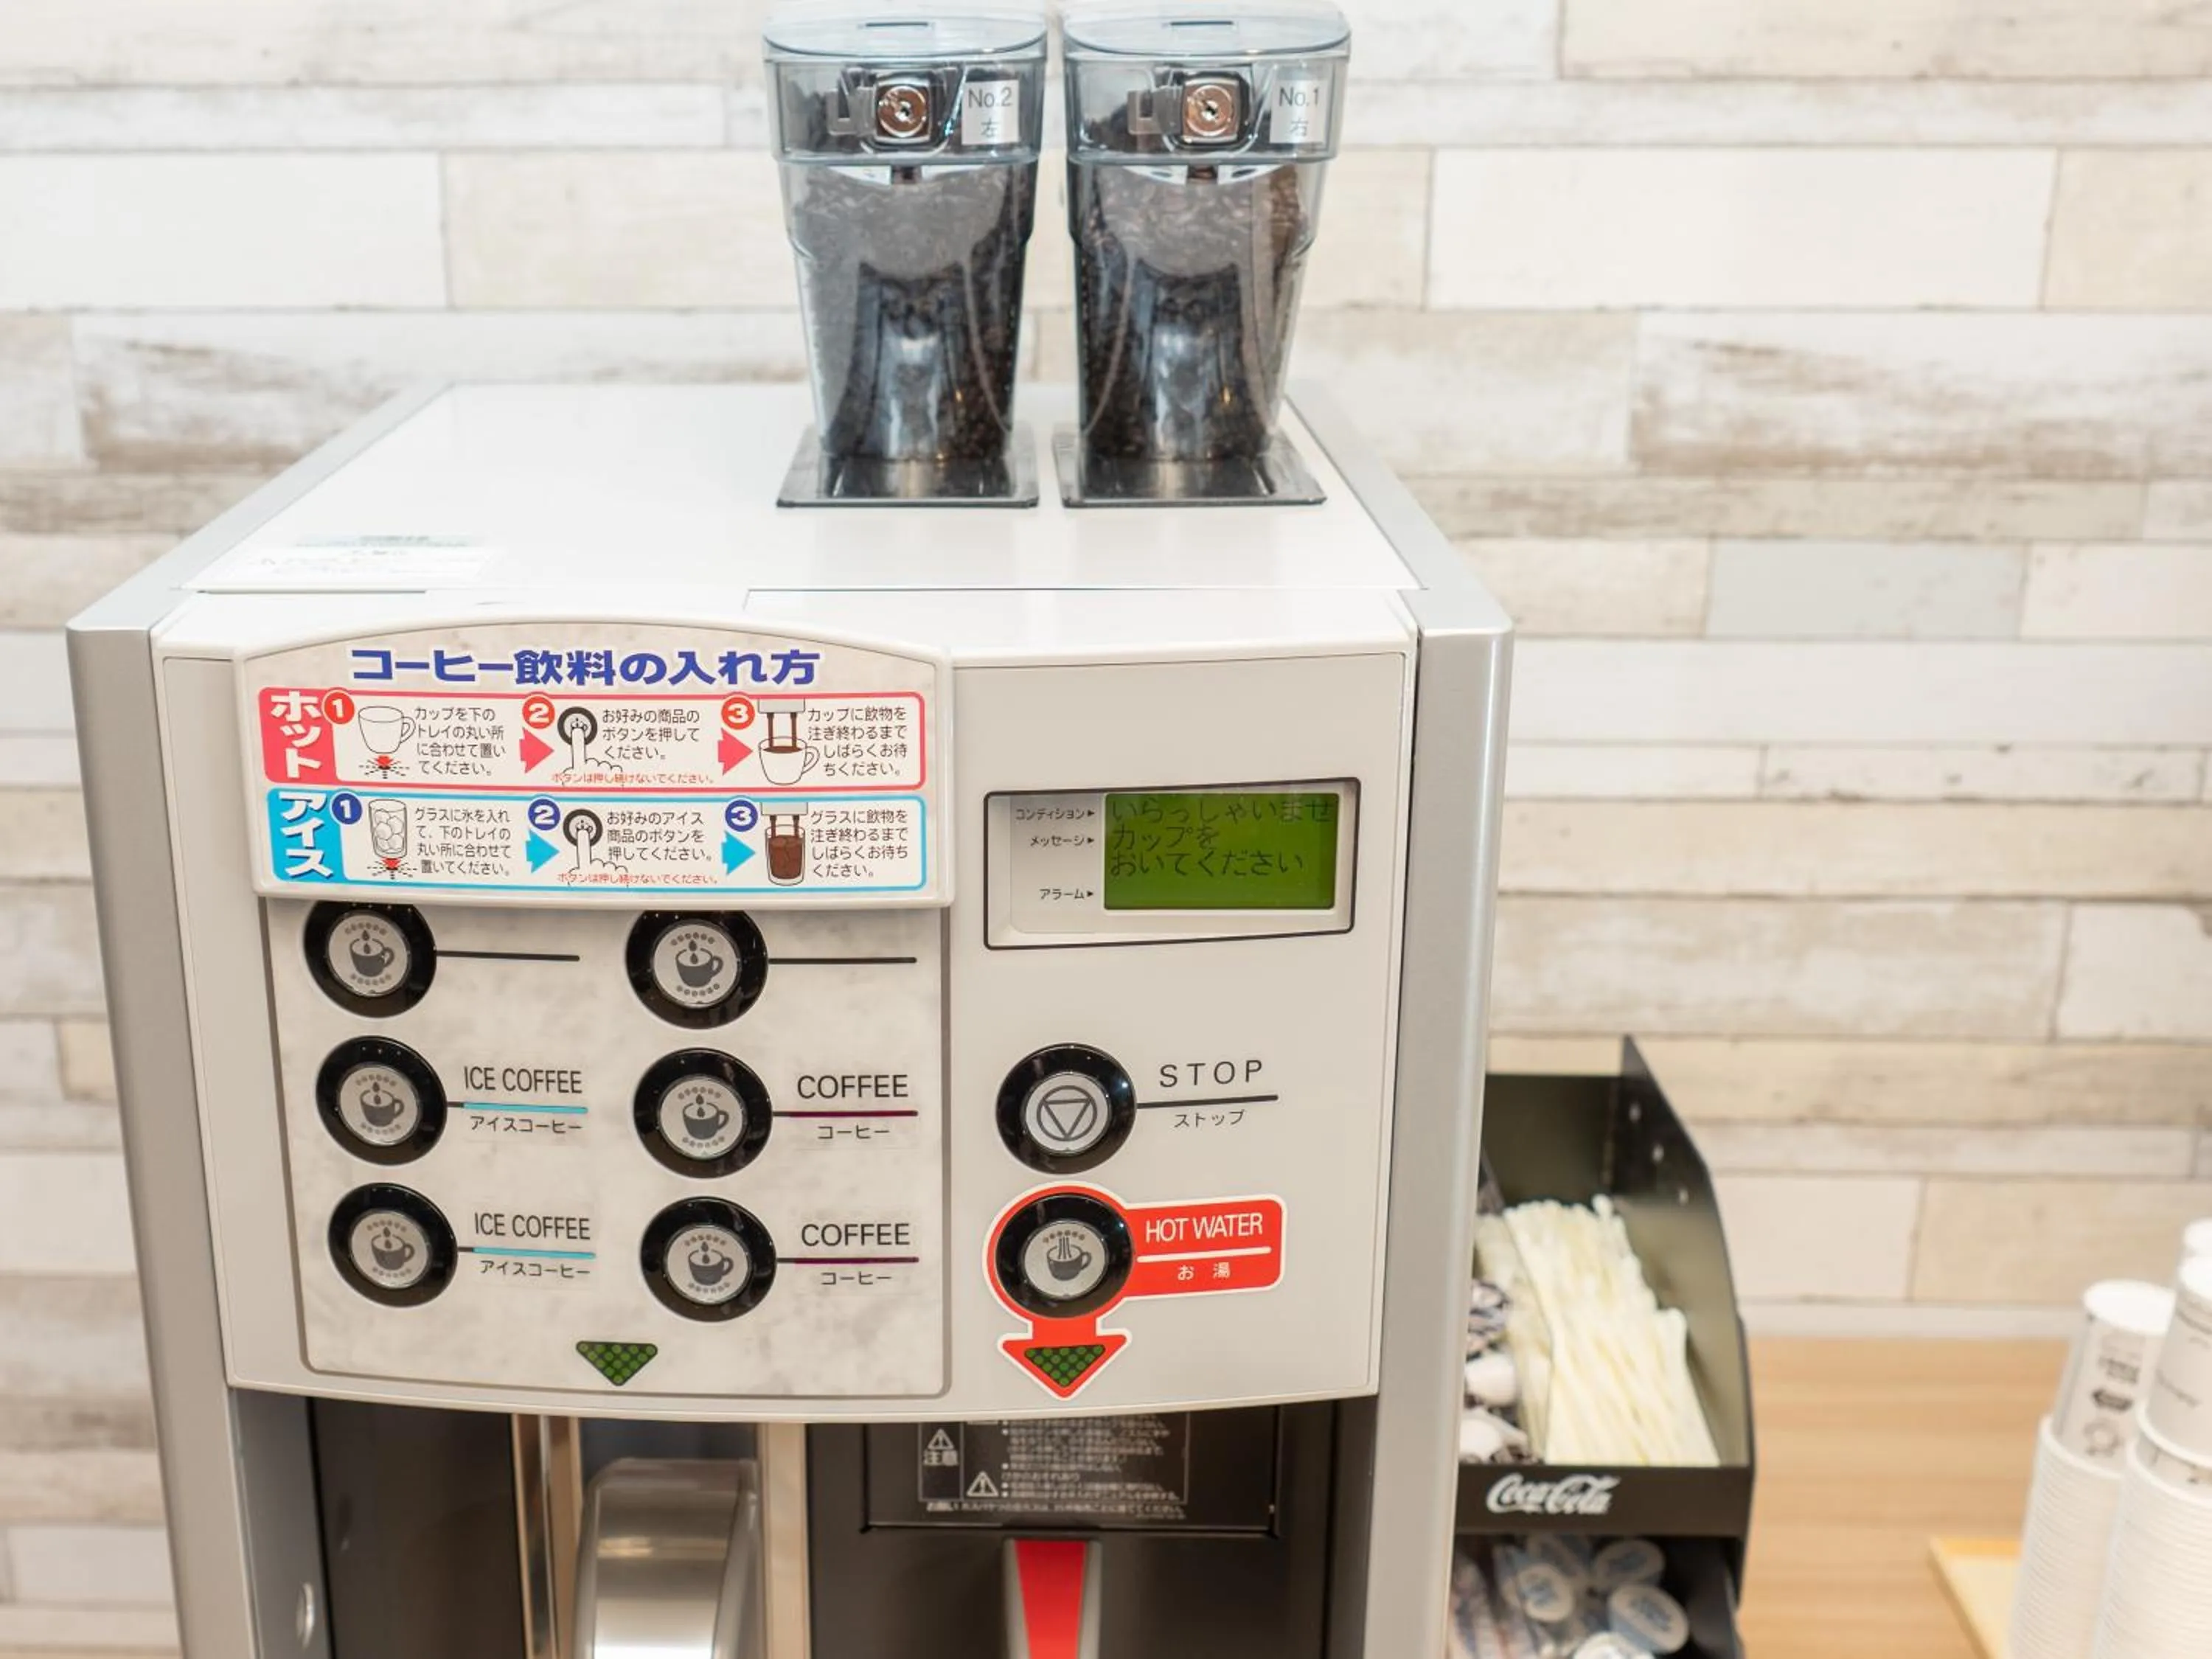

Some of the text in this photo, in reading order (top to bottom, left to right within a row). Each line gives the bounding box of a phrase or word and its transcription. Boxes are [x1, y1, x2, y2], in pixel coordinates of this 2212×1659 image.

[968, 86, 1014, 108] No.2
[1279, 86, 1318, 107] No.1
[981, 116, 998, 138] 左
[352, 649, 820, 686] コーヒー飲料の入れ方
[415, 706, 495, 721] カップを下の
[602, 709, 700, 723] お好みの商品の
[807, 706, 906, 722] カップに飲物を
[271, 691, 321, 779] ホット
[418, 724, 505, 740] トレイの丸い所
[602, 727, 700, 742] ボタンを押して
[807, 725, 907, 741] 注ぎ終わるまで
[417, 742, 506, 758] に合わせて置い
[605, 745, 666, 760] ください。
[824, 743, 907, 759] しばらくお待
[418, 760, 492, 776] てください。
[824, 762, 900, 776] ちください。
[415, 807, 511, 823] グラスに氷を入れ
[607, 811, 705, 825] お好みのアイス
[810, 809, 908, 824] グラスに飲物を
[1015, 807, 1085, 821] コンディション
[1113, 797, 1333, 825] いらっしゃいませ
[279, 791, 334, 878] アイス
[607, 829, 705, 843] 商品のボタンを
[810, 827, 908, 843] 注ぎ終わるまで
[1030, 835, 1085, 847] メッセージ
[1112, 824, 1220, 851] カップを
[417, 843, 511, 858] 丸い所に合わせて
[608, 846, 712, 861] 押してください。
[812, 846, 908, 860] しばらくお待ち
[421, 860, 510, 877] 置いてください。
[813, 863, 874, 877] ください。
[1110, 849, 1304, 877] おいてください
[1039, 888, 1085, 900] アラーム
[464, 1066, 582, 1094] ICE COFFEE
[1160, 1060, 1262, 1088] STOP
[797, 1074, 908, 1099] COFFEE
[470, 1116, 582, 1133] アイスコーヒー
[1174, 1108, 1245, 1128] ストップ
[818, 1123, 890, 1139] コーヒー
[474, 1212, 591, 1240] ICE COFFEE
[1146, 1212, 1263, 1243] HOT WATER
[801, 1223, 910, 1247] COFFEE
[480, 1259, 591, 1279] アイスコーヒー
[821, 1271, 892, 1286] コーヒー
